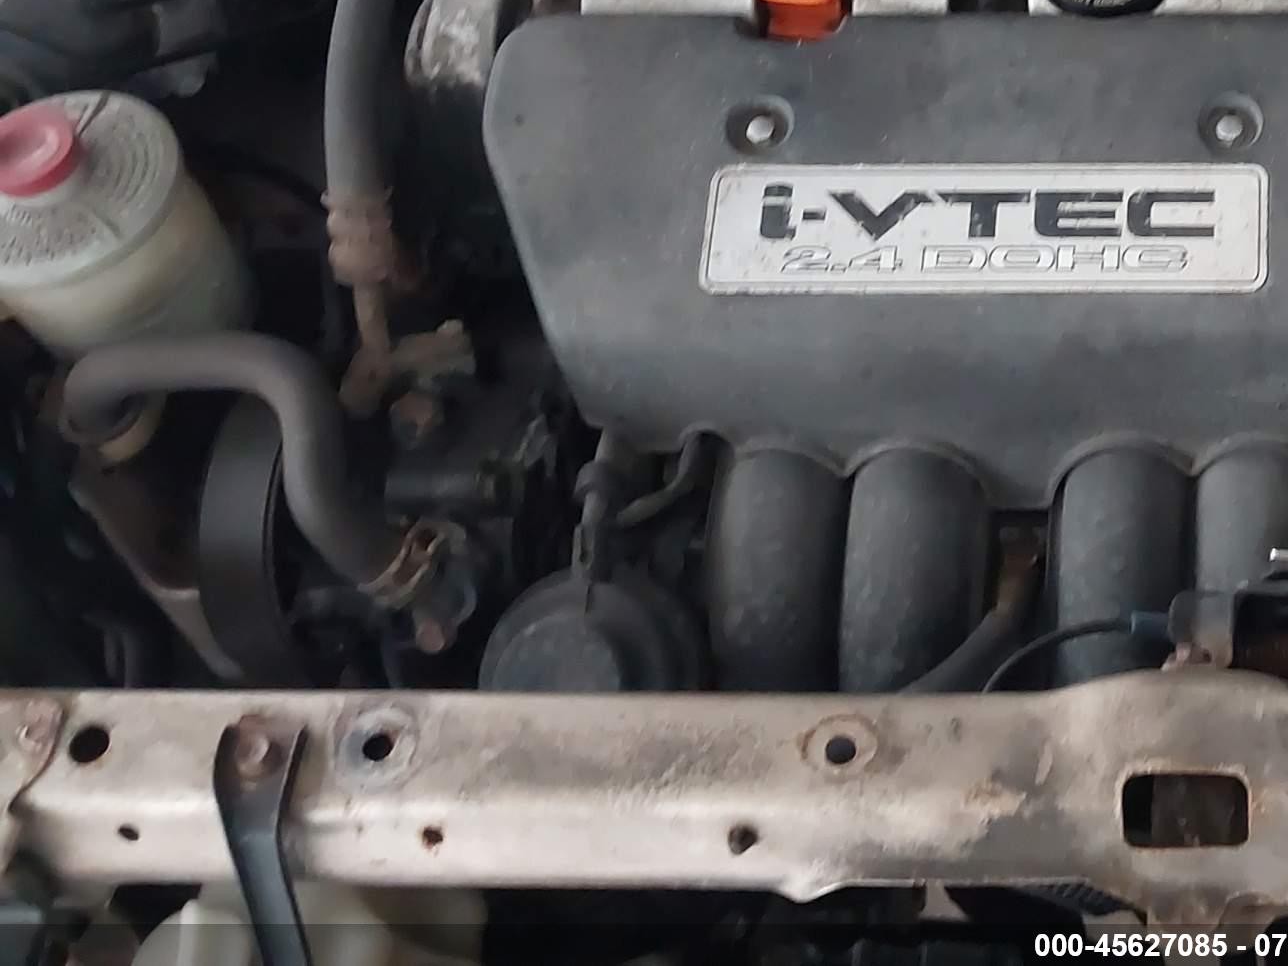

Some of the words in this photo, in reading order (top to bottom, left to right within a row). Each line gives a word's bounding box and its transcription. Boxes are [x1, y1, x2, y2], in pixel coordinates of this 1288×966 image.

[758, 181, 1217, 242] i-VTEC
[781, 244, 904, 275] 2.4
[919, 244, 1190, 274] DOHC
